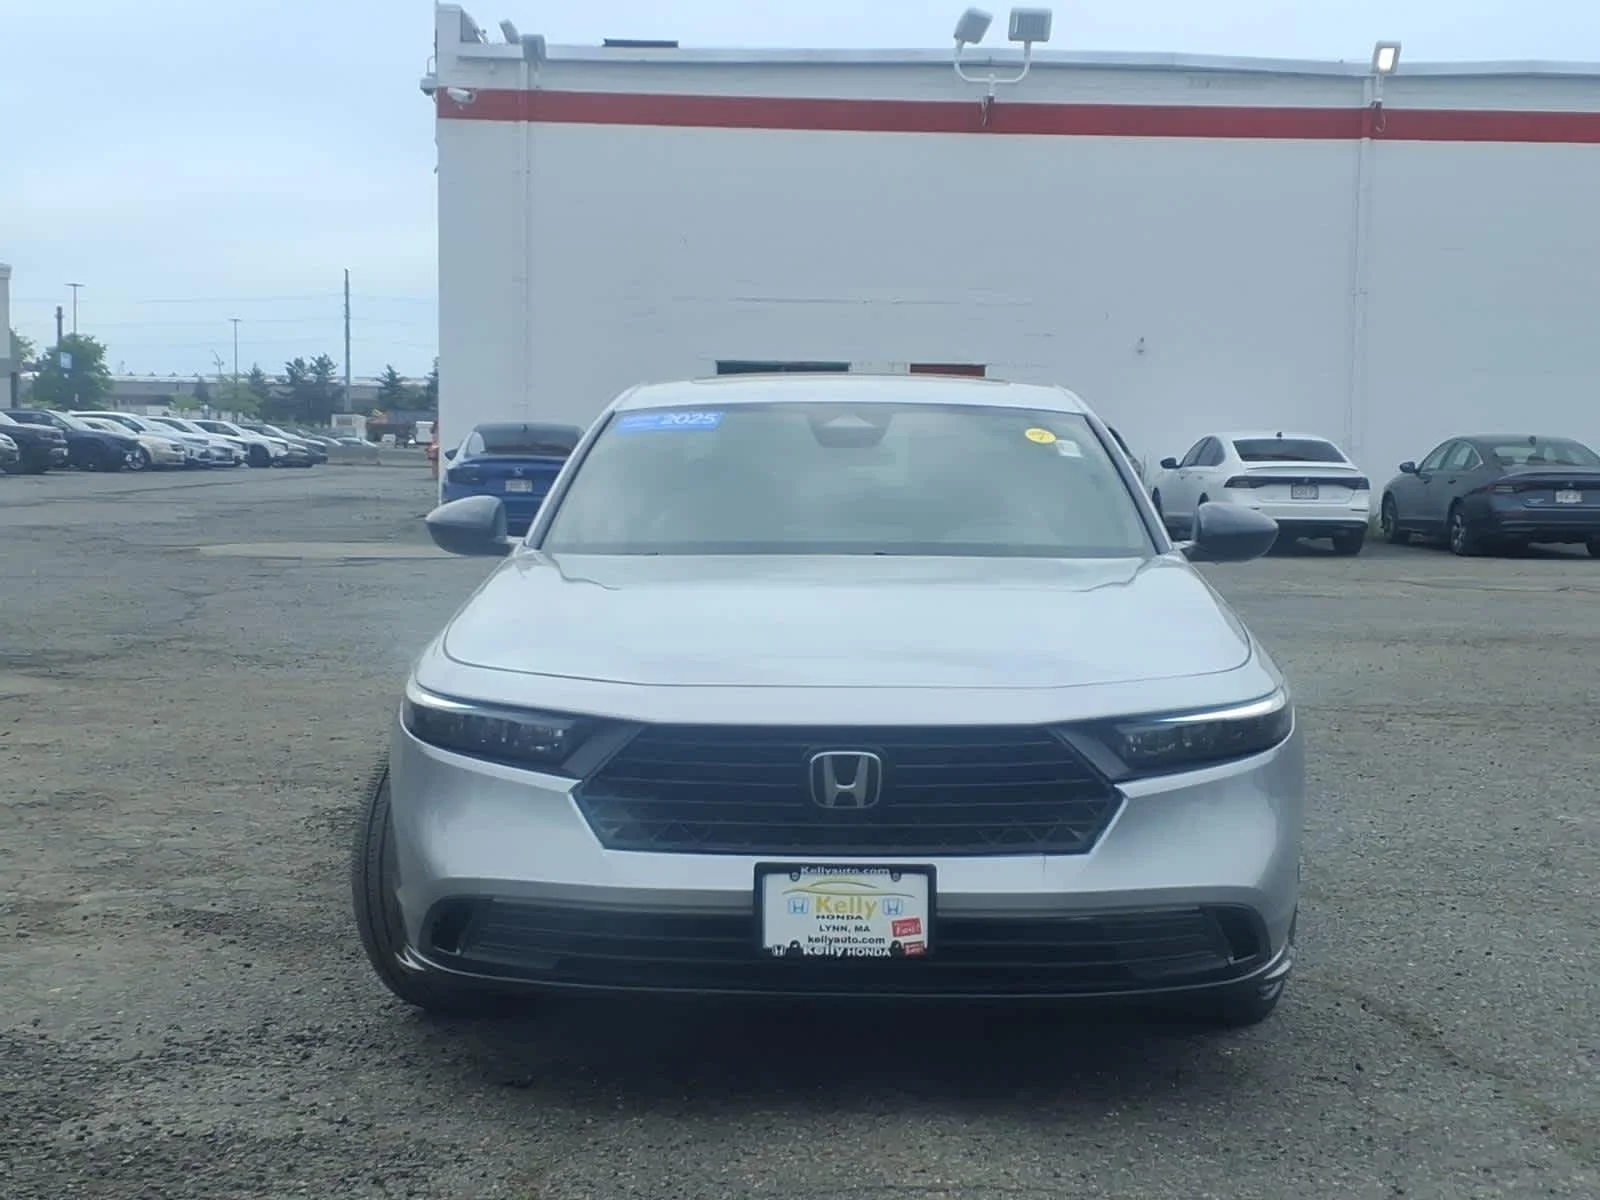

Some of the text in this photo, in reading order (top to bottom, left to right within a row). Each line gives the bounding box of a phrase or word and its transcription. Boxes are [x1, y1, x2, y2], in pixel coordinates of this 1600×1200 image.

[660, 412, 718, 425] 2025
[800, 866, 890, 876] Kellyauto.com
[815, 896, 877, 919] Kelly
[819, 925, 851, 933] LYNN,
[807, 935, 885, 946] kellyauto.com
[803, 946, 892, 957] Kelly HONDA
